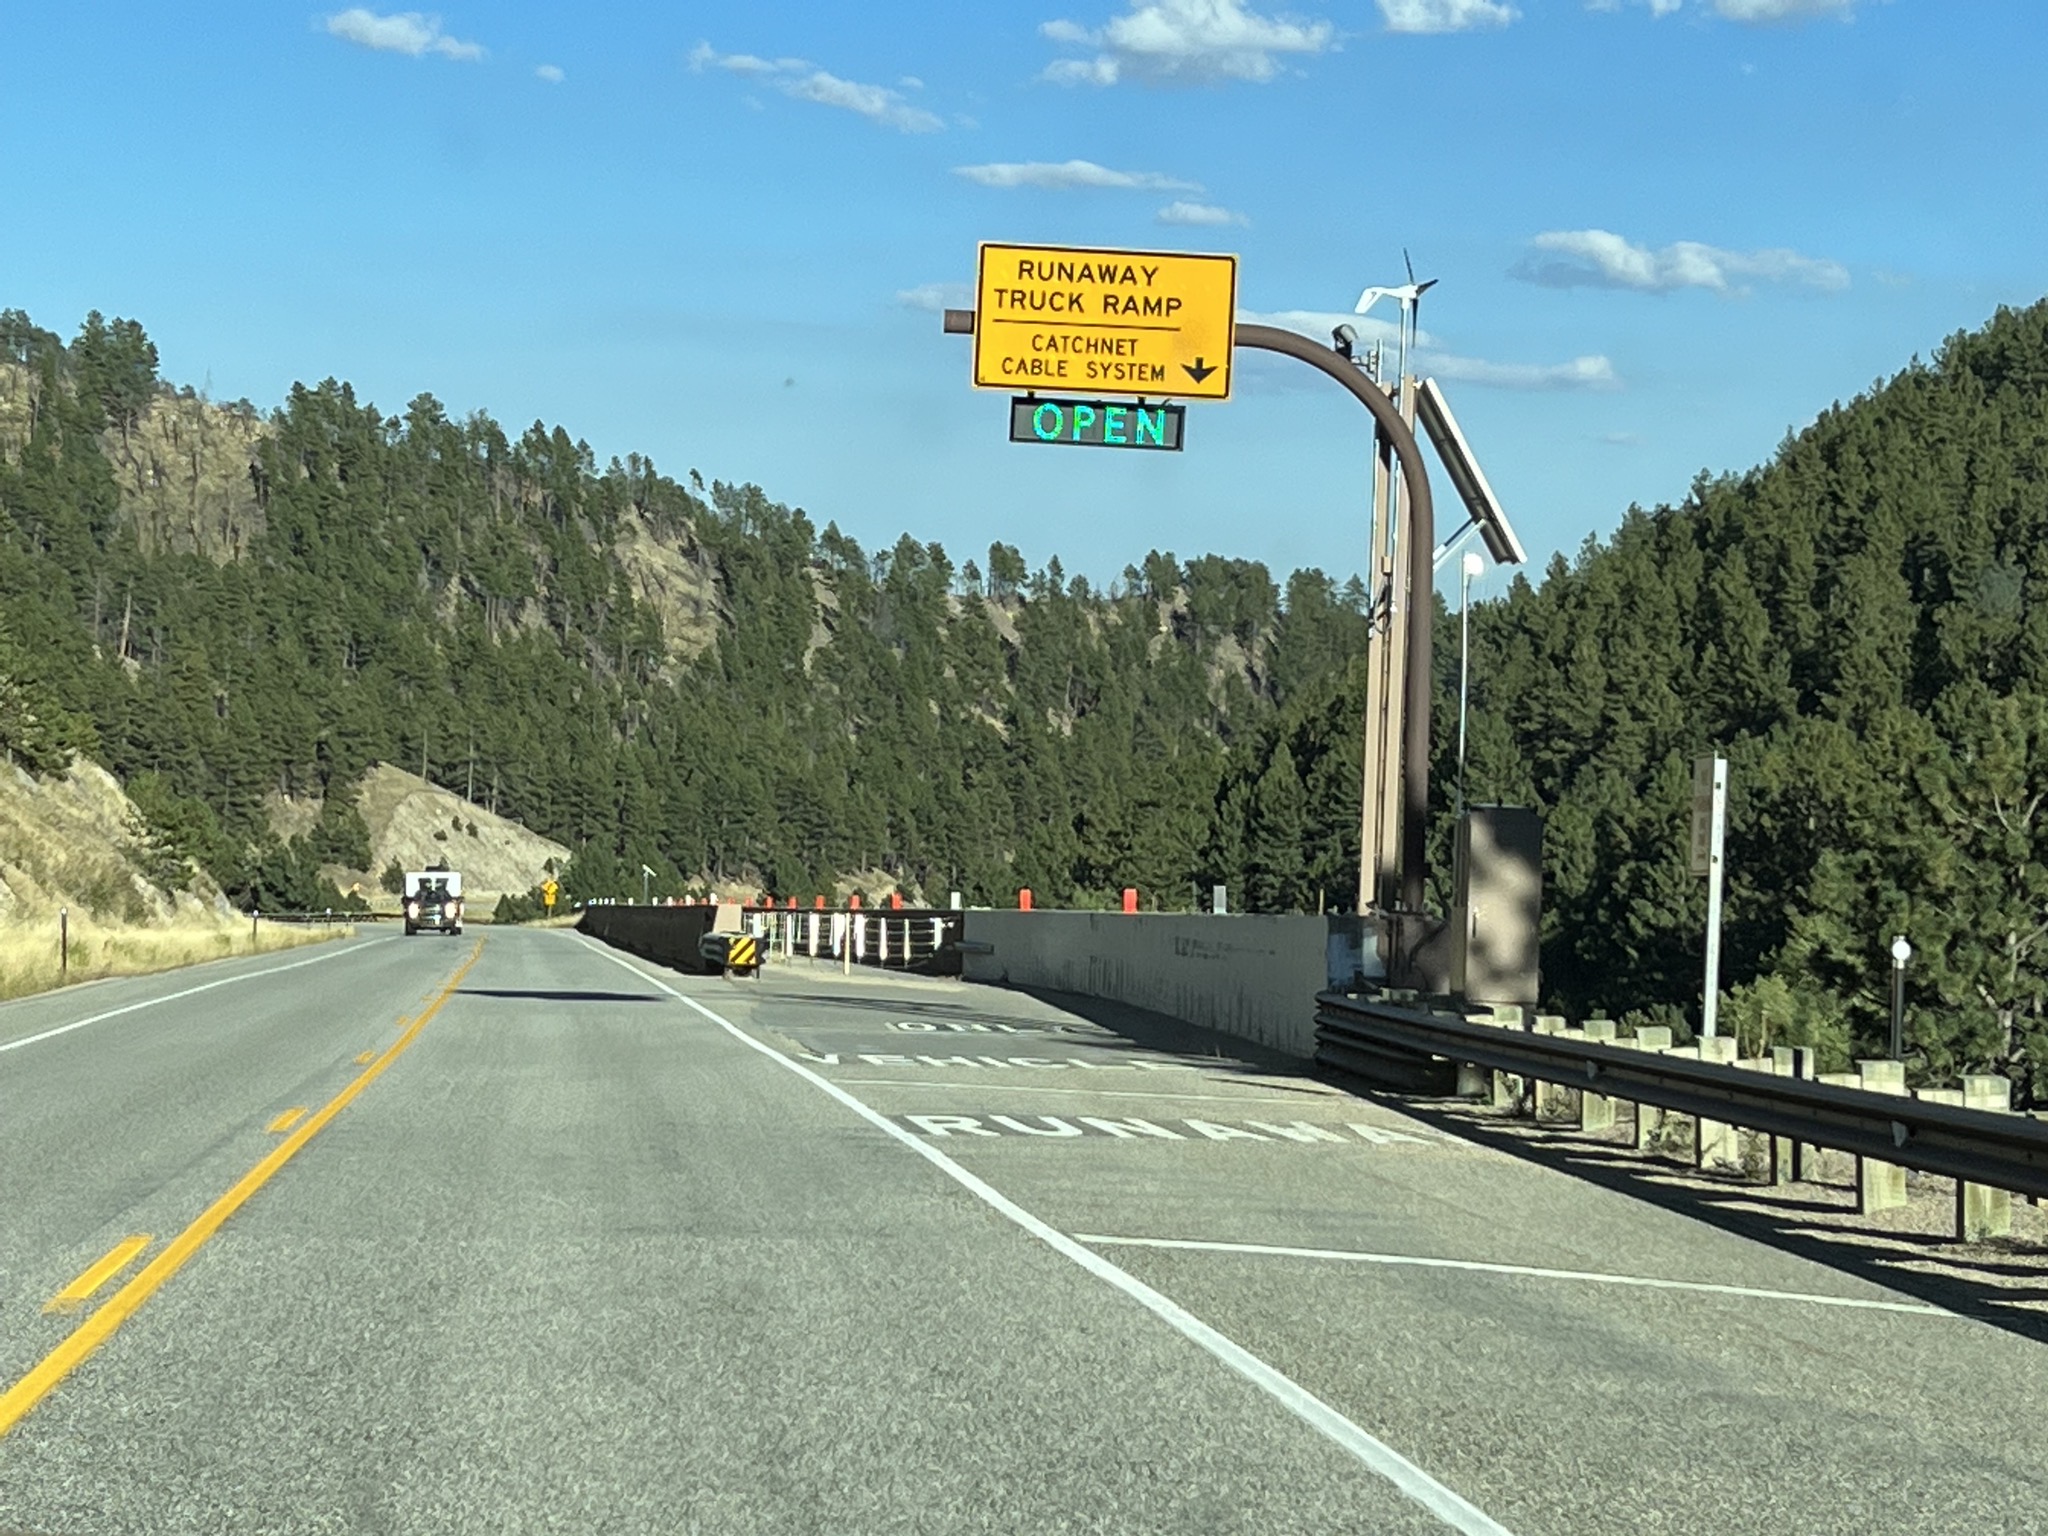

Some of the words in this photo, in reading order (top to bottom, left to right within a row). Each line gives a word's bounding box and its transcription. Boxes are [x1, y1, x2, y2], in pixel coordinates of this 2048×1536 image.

[1018, 259, 1159, 287] RUNAWAY
[994, 288, 1085, 314] TRUCK
[1103, 294, 1183, 318] RAMP
[1031, 334, 1138, 356] CATCHNET
[1001, 356, 1068, 377] CABLE
[1086, 360, 1166, 382] SYSTEM
[1032, 402, 1167, 446] OPEN
